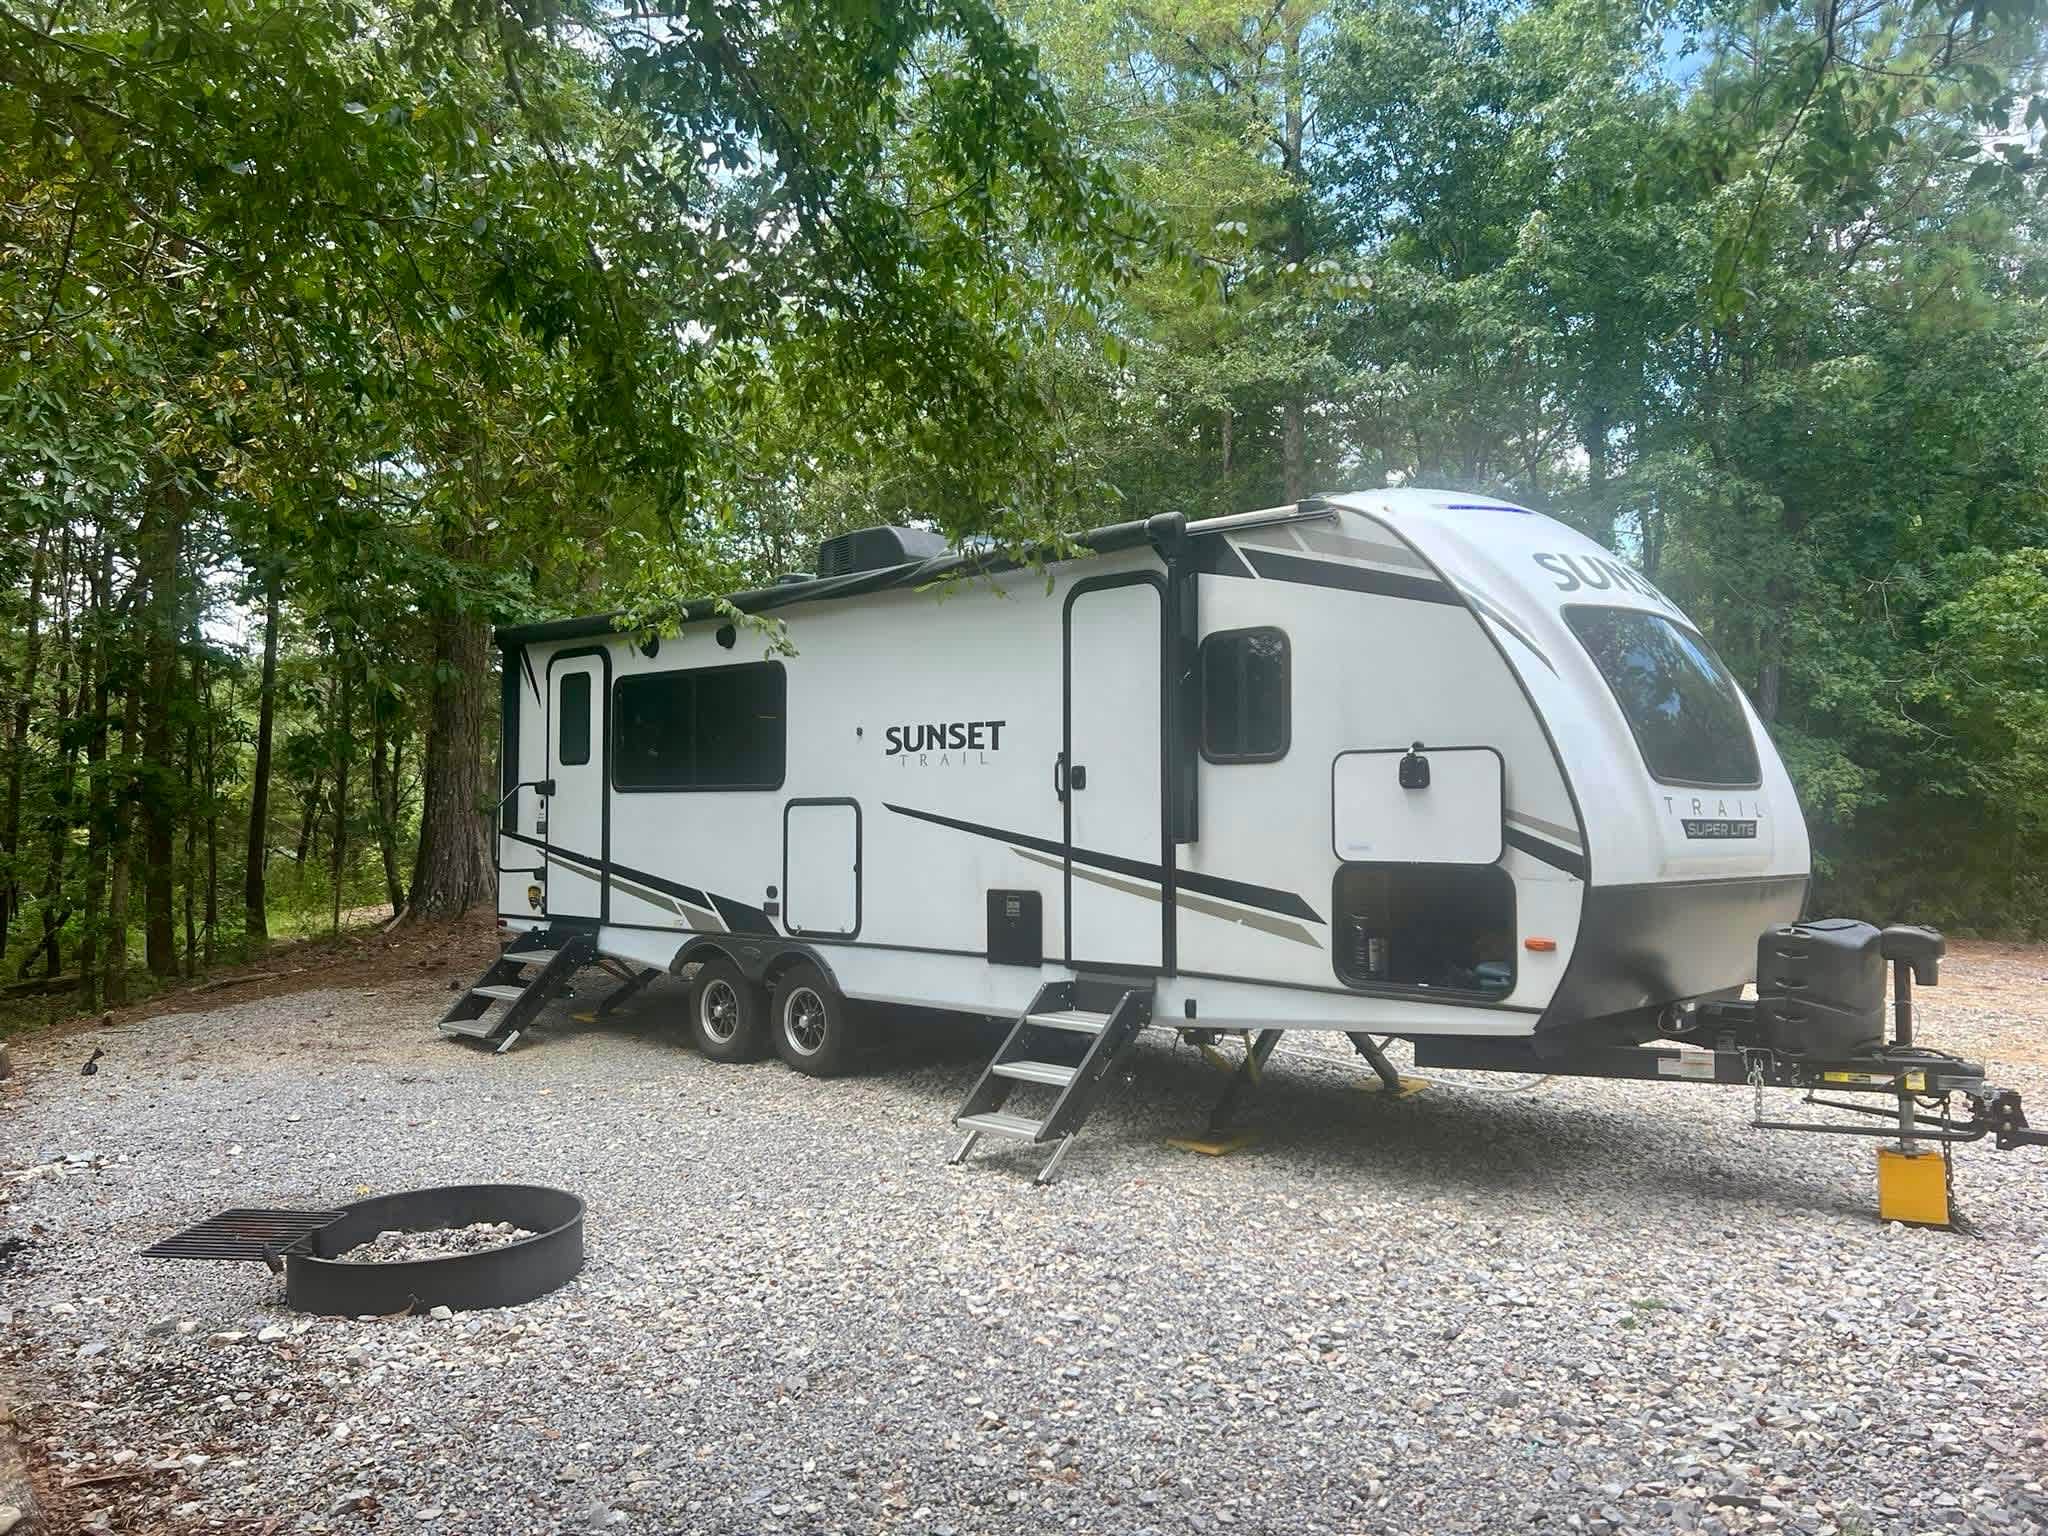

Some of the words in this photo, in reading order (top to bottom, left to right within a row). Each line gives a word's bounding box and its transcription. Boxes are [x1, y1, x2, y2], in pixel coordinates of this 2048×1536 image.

[886, 720, 1006, 755] SUNSET
[899, 751, 990, 768] TRAIL
[1663, 796, 1763, 818] TRAIL
[1687, 822, 1729, 837] SUPER
[1731, 822, 1755, 837] LITE
